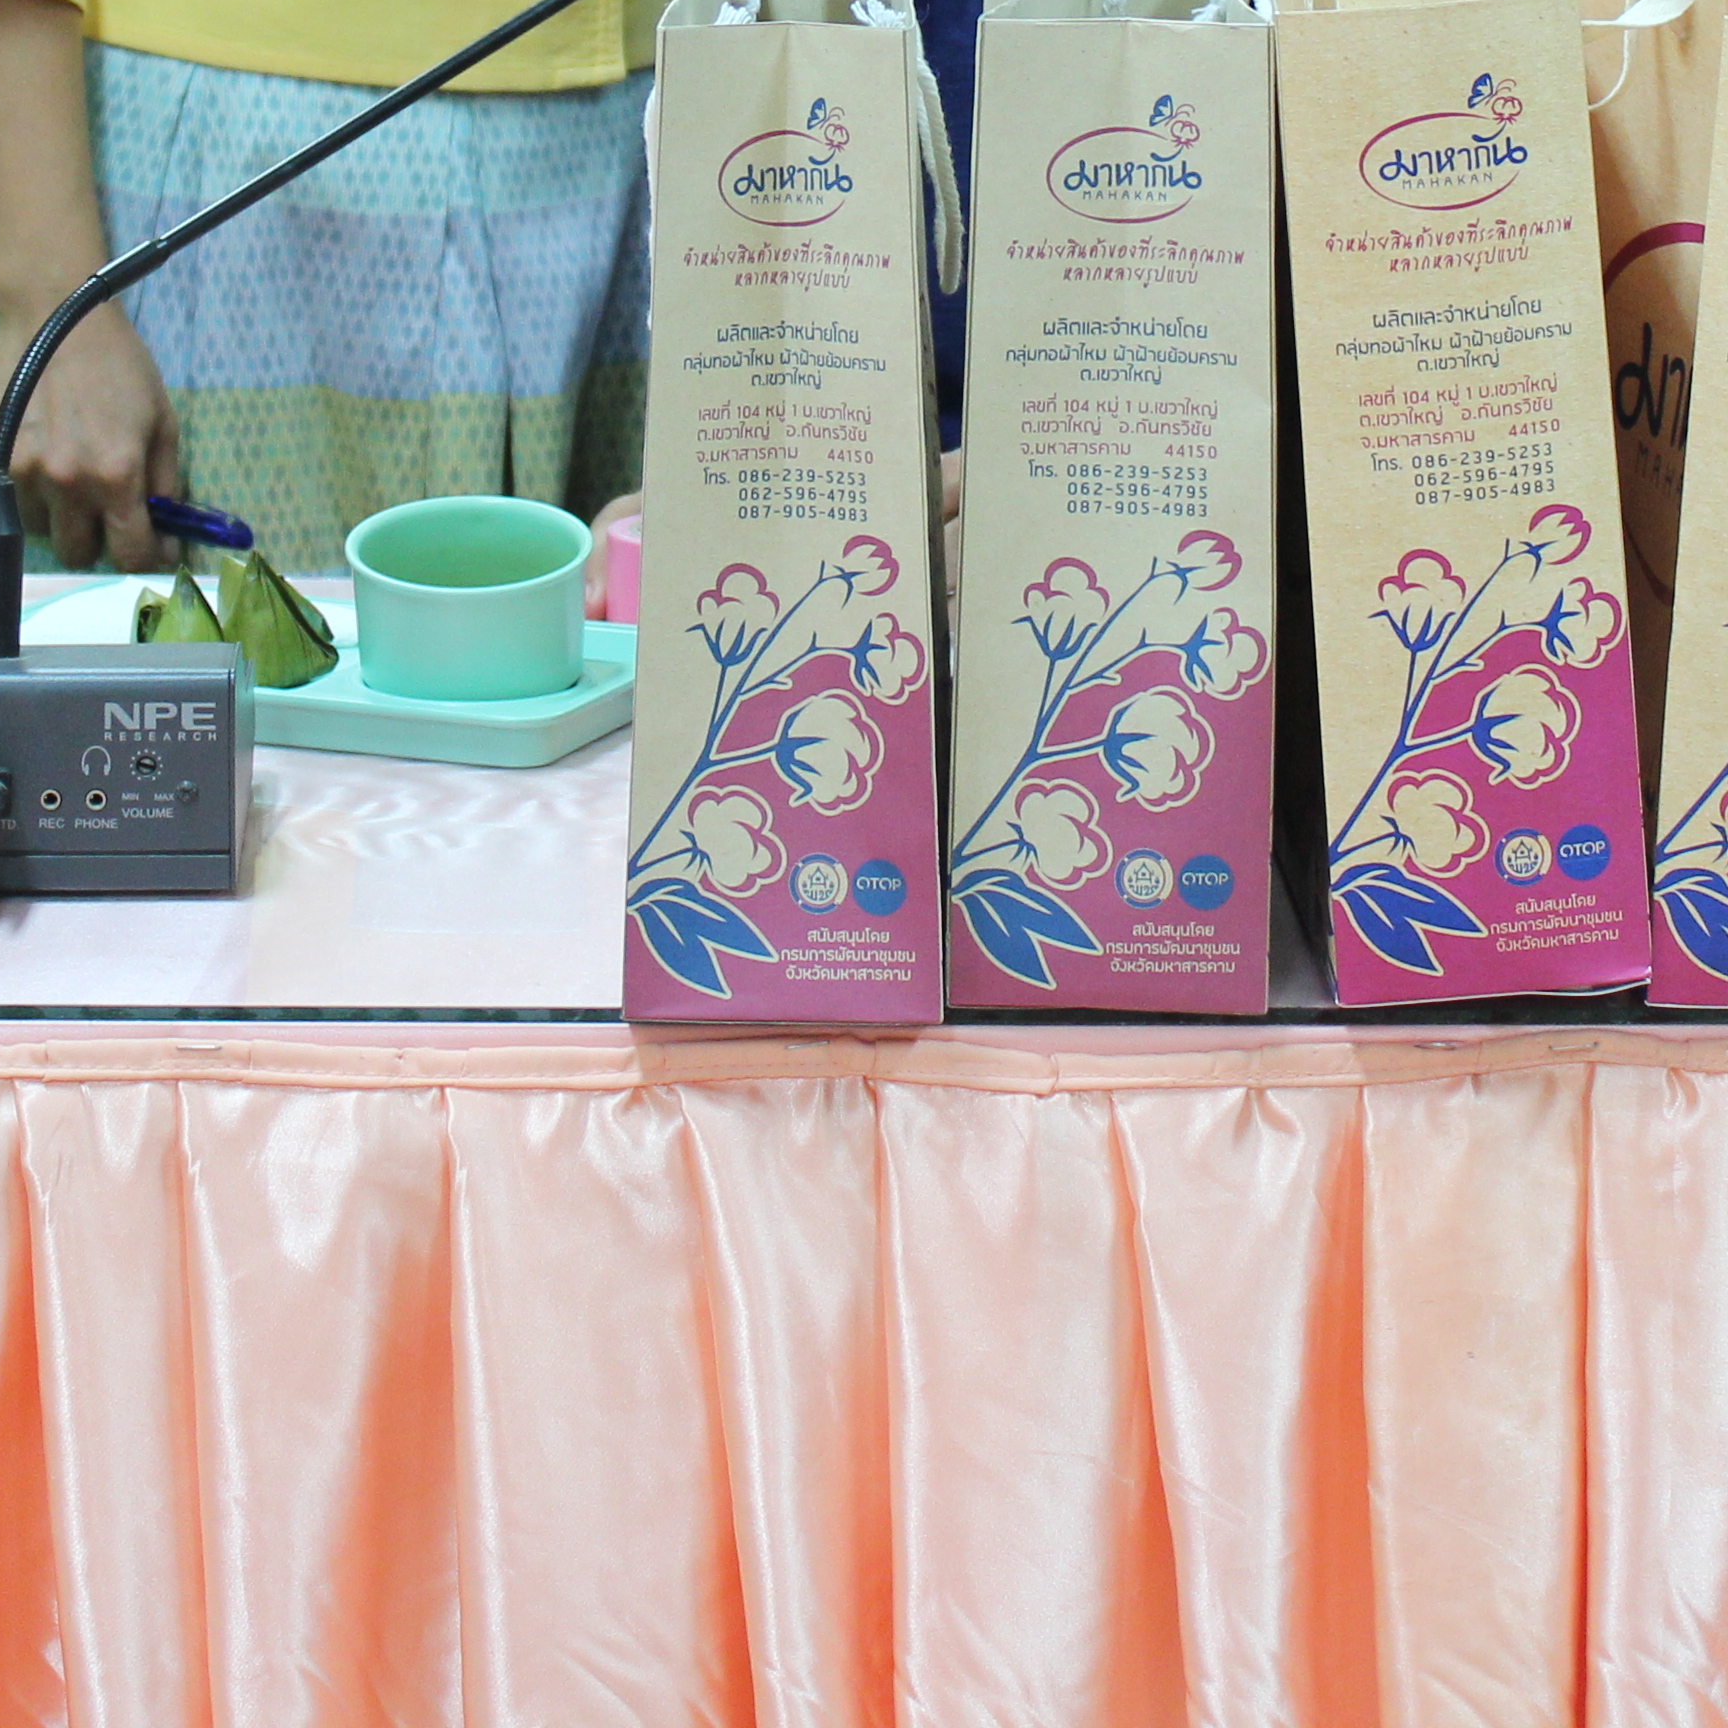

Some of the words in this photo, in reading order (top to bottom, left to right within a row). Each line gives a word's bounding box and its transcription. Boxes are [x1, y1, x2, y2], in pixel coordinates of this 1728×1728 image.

[1402, 172, 1494, 190] MAHAKAN
[751, 194, 824, 205] MAHAKAN
[1082, 190, 1167, 202] MAHAKAN
[1372, 295, 1542, 329] ผลิตและจำหน่ายโดย
[717, 320, 859, 343] ผลิตและจำหน่ายโดย
[1042, 316, 1208, 339] ผลิตและจำหน่ายโดย
[1417, 348, 1500, 372] ต.เขวาใหญ่
[751, 367, 822, 390] ต.เขวาใหญ่
[1080, 363, 1162, 385] ต.เขวาใหญ่
[1358, 385, 1395, 408] เลขที่
[1402, 389, 1429, 405] 104
[1437, 384, 1459, 408] หมู่
[1478, 372, 1558, 400] บ.เขวาใหญ่
[698, 400, 731, 422] เลขที่
[737, 405, 760, 418] 104
[766, 400, 785, 423] หมู่
[803, 402, 872, 425] บ.เขวาใหญ่
[1022, 393, 1057, 413] เลขที่
[1064, 399, 1089, 413] 104
[1096, 395, 1119, 419] หมู่
[1138, 397, 1218, 420] บ.เขวาใหญ่
[1359, 407, 1443, 429] ต.เขวาใหญ่
[1460, 396, 1553, 422] อ.กันทรวิชัย
[697, 421, 770, 442] ต.เขวาใหญ่
[786, 423, 867, 442] อ.กันทรวิชัย
[1021, 414, 1102, 435] ต.เขวาใหญ่
[1119, 418, 1212, 437] อ.กันทรวิชัย
[1361, 428, 1475, 450] จ.มหาสารคาม
[1508, 419, 1560, 437] 44150
[696, 446, 798, 463] จ.มหาสารคาม
[827, 449, 874, 464] 44150
[1020, 441, 1131, 456] จ.มหาสารคาม
[1164, 443, 1217, 459] 44150
[1371, 453, 1403, 473] โทร.
[1411, 441, 1553, 470] 086-239-5253
[703, 467, 730, 485] โทร.
[738, 469, 866, 486] 086-239-5253
[1029, 459, 1058, 478] โทร.
[1066, 463, 1208, 481] 086-239-5253
[1414, 460, 1555, 488] 062-596-4795
[739, 487, 867, 504] 062-596-4795
[1067, 482, 1208, 499] 062-596-4795
[1415, 478, 1556, 506] 087-905-4983
[738, 505, 868, 522] 087-905-4983
[1066, 500, 1208, 518] 087-905-4983
[104, 701, 217, 731] NPE
[104, 732, 217, 742] RESEARCH
[122, 793, 140, 802] MIN
[154, 793, 175, 802] MAX
[122, 807, 174, 819] VOLUME
[39, 818, 65, 829] REC
[74, 818, 118, 829] PHONE
[1559, 840, 1606, 858] OTOP
[856, 876, 902, 891] OTOP
[1181, 871, 1230, 886] OTOP
[1515, 893, 1597, 915] สนับสนุนโดย
[807, 927, 889, 946] สนับสนุนโดย
[1132, 921, 1215, 941] สนับสนุนโดย
